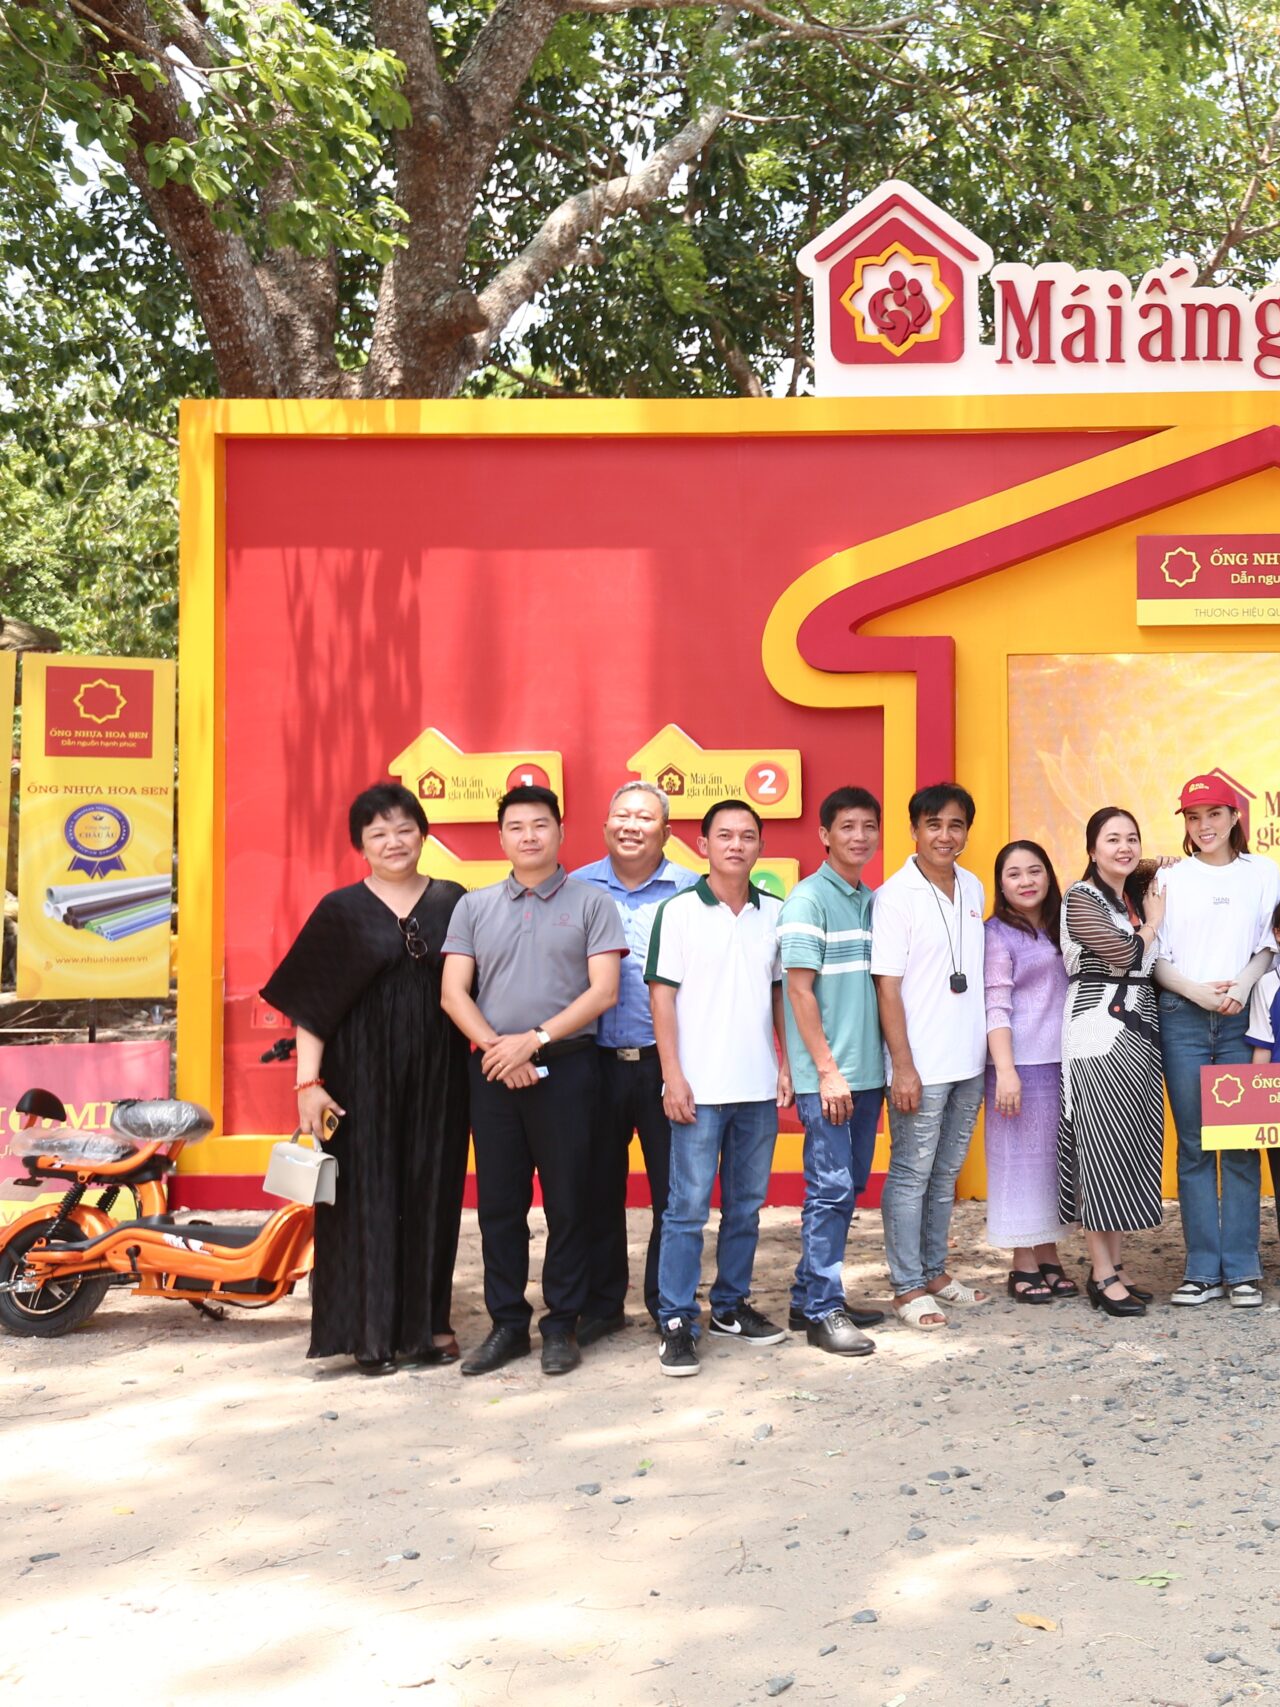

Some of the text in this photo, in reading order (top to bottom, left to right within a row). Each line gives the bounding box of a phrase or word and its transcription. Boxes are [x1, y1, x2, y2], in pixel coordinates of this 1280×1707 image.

[997, 279, 1125, 364] Mái
[1138, 267, 1244, 363] ấm
[1210, 547, 1249, 566] ỐNG
[1231, 569, 1256, 584] Dẫn
[1242, 607, 1265, 619] HIỆU
[105, 731, 126, 739] HOA
[128, 731, 149, 739] SEN
[27, 782, 168, 796] ỐNG NHỰA HOA SEN
[757, 769, 777, 794] 2
